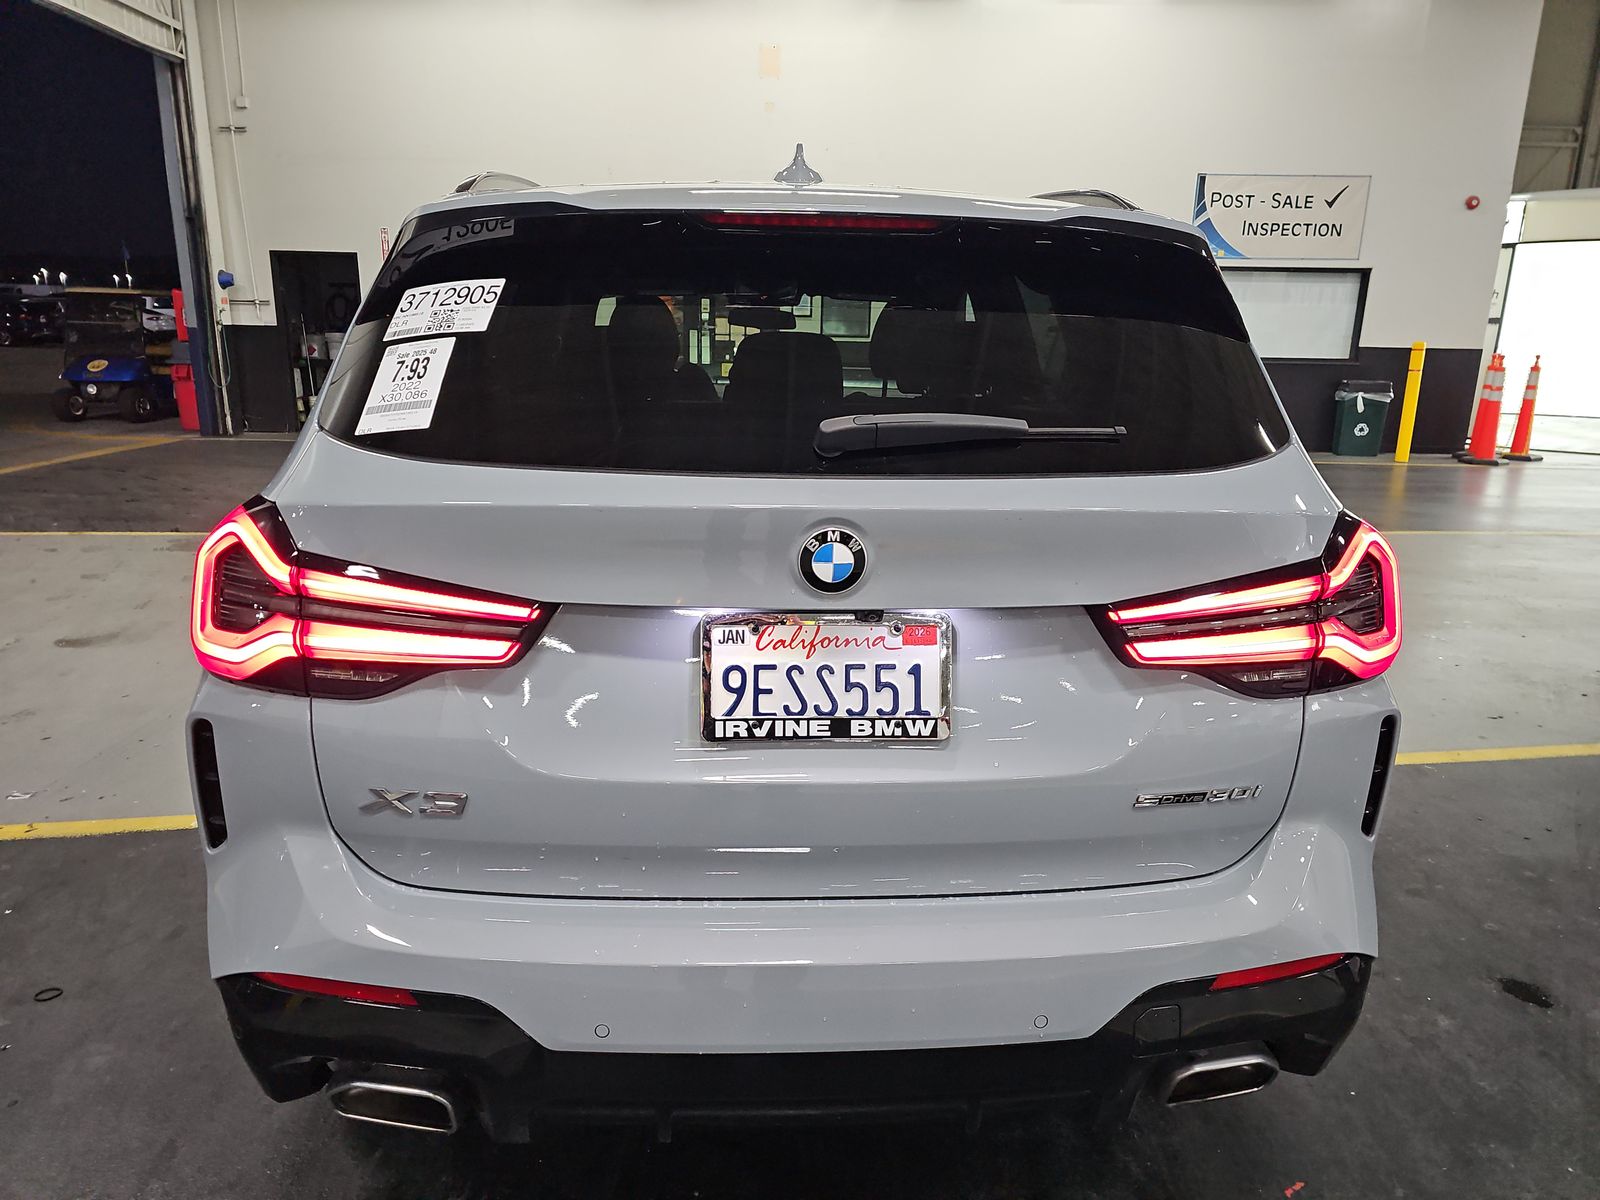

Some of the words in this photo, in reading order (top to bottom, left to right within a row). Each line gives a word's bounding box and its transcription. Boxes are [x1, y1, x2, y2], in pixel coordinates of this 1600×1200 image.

[1210, 192, 1255, 209] POST
[1271, 192, 1314, 209] SALE
[1241, 220, 1343, 237] INSPECTION
[400, 285, 501, 313] 3712905
[389, 319, 409, 329] DLR
[396, 352, 411, 360] Sale
[411, 349, 427, 358] 2025
[428, 347, 438, 355] 48
[391, 356, 431, 383] 7:93
[391, 380, 421, 392] 2022
[805, 530, 862, 553] BMW
[718, 629, 745, 645] JAN
[755, 624, 903, 660] California
[721, 663, 931, 717] 9ESS551
[714, 719, 831, 738] IRVINE
[850, 719, 936, 737] BMW
[358, 786, 469, 817] X3
